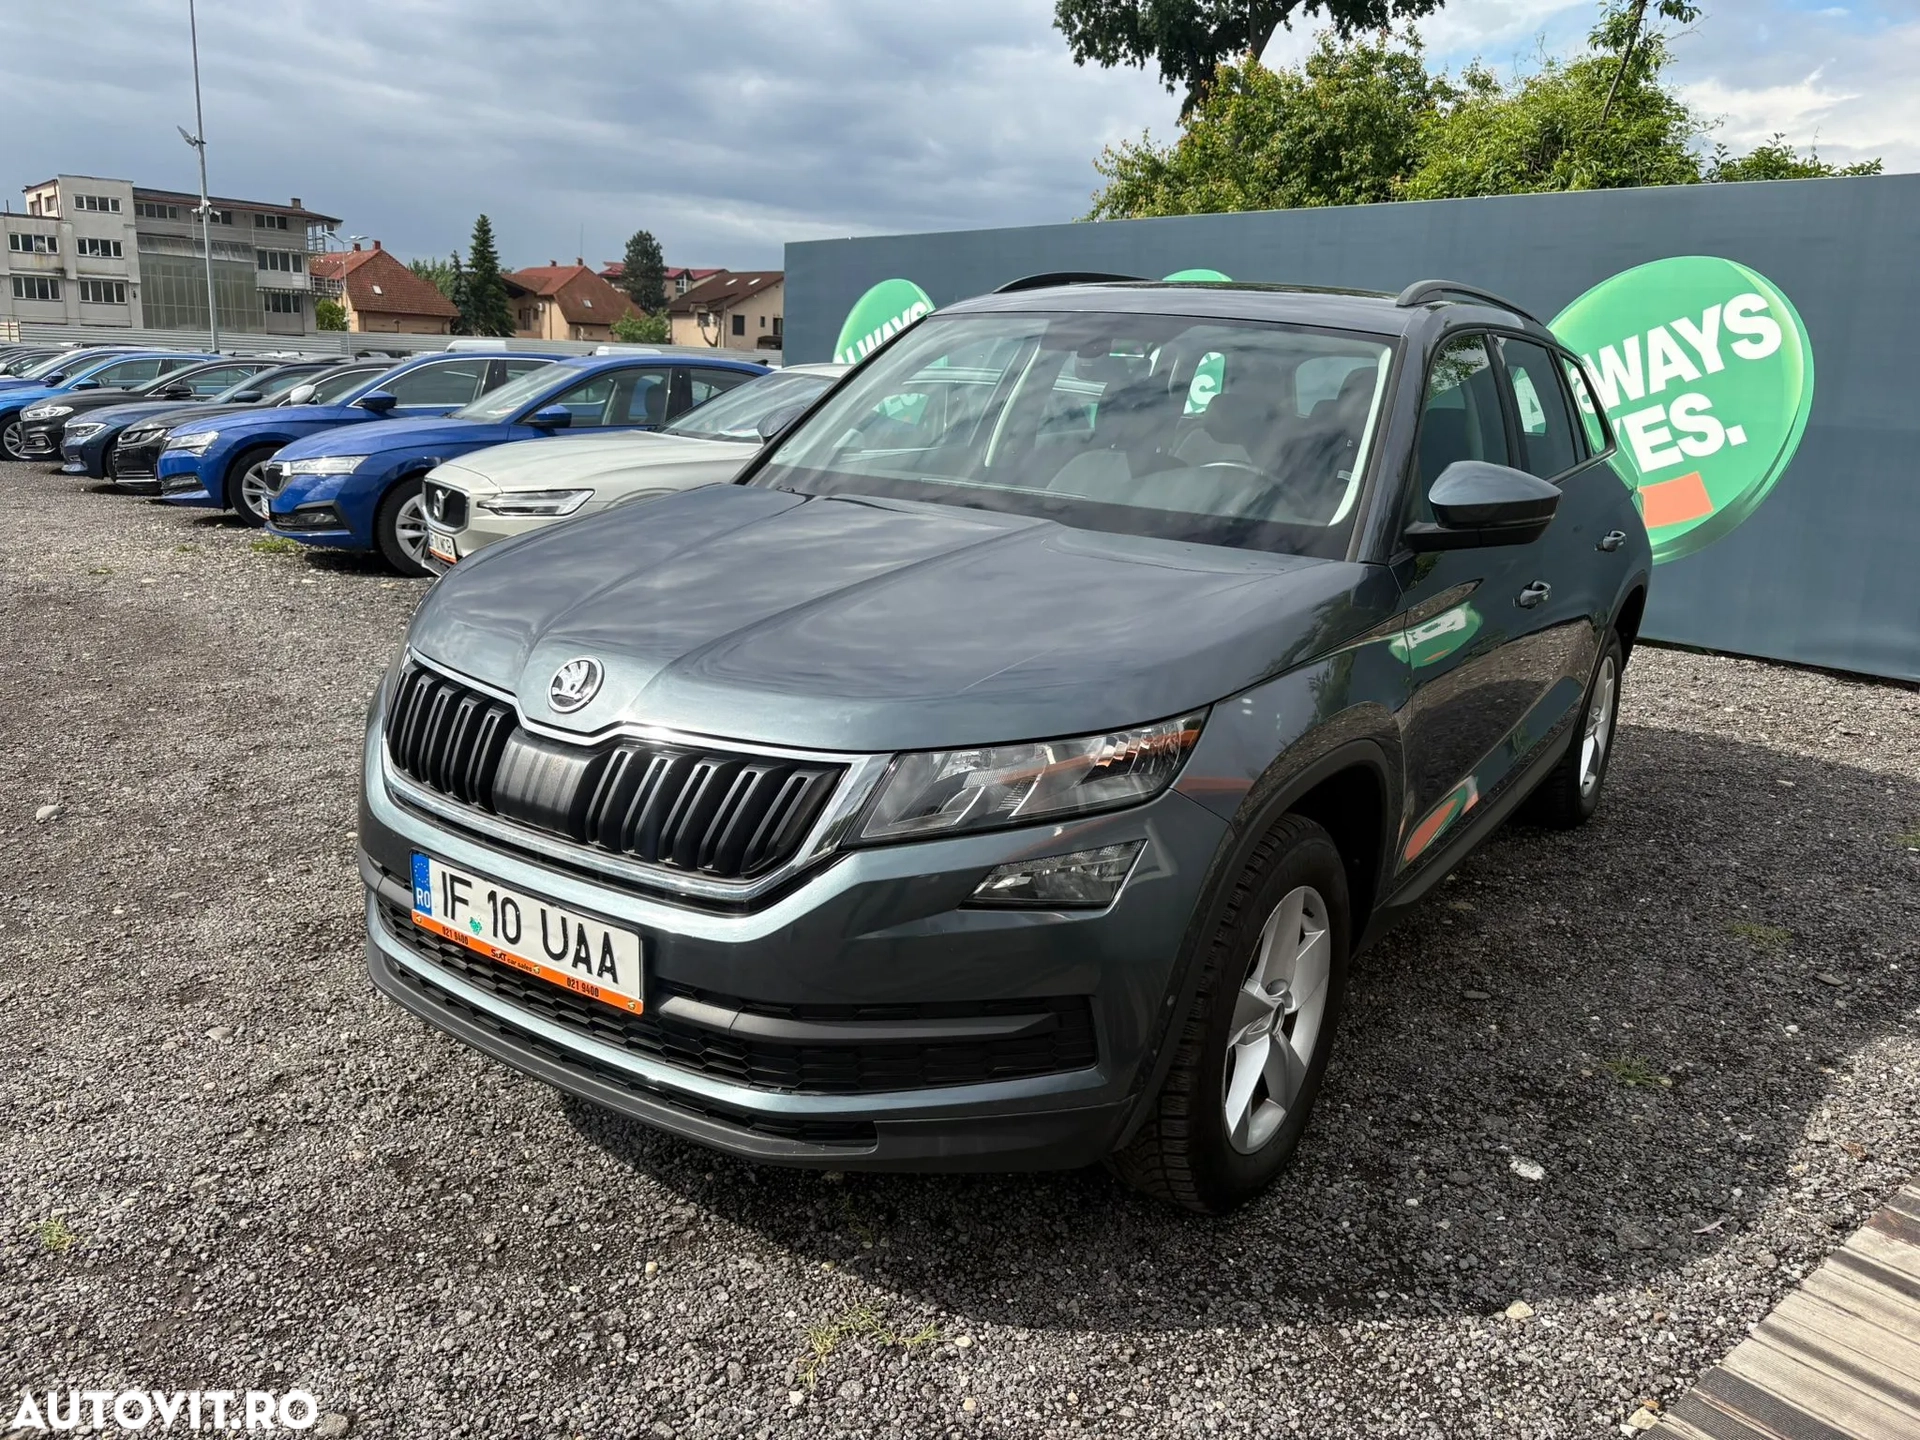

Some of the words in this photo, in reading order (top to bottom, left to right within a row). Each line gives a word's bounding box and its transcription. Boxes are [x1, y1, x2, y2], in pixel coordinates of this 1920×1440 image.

[1581, 293, 1782, 414] WAYS
[416, 887, 431, 909] RO
[441, 870, 473, 921] IF
[487, 889, 522, 945] 10
[540, 908, 619, 984] UAA
[507, 958, 517, 966] car
[517, 962, 533, 972] sales
[566, 977, 579, 990] 021
[581, 982, 599, 998] 9400
